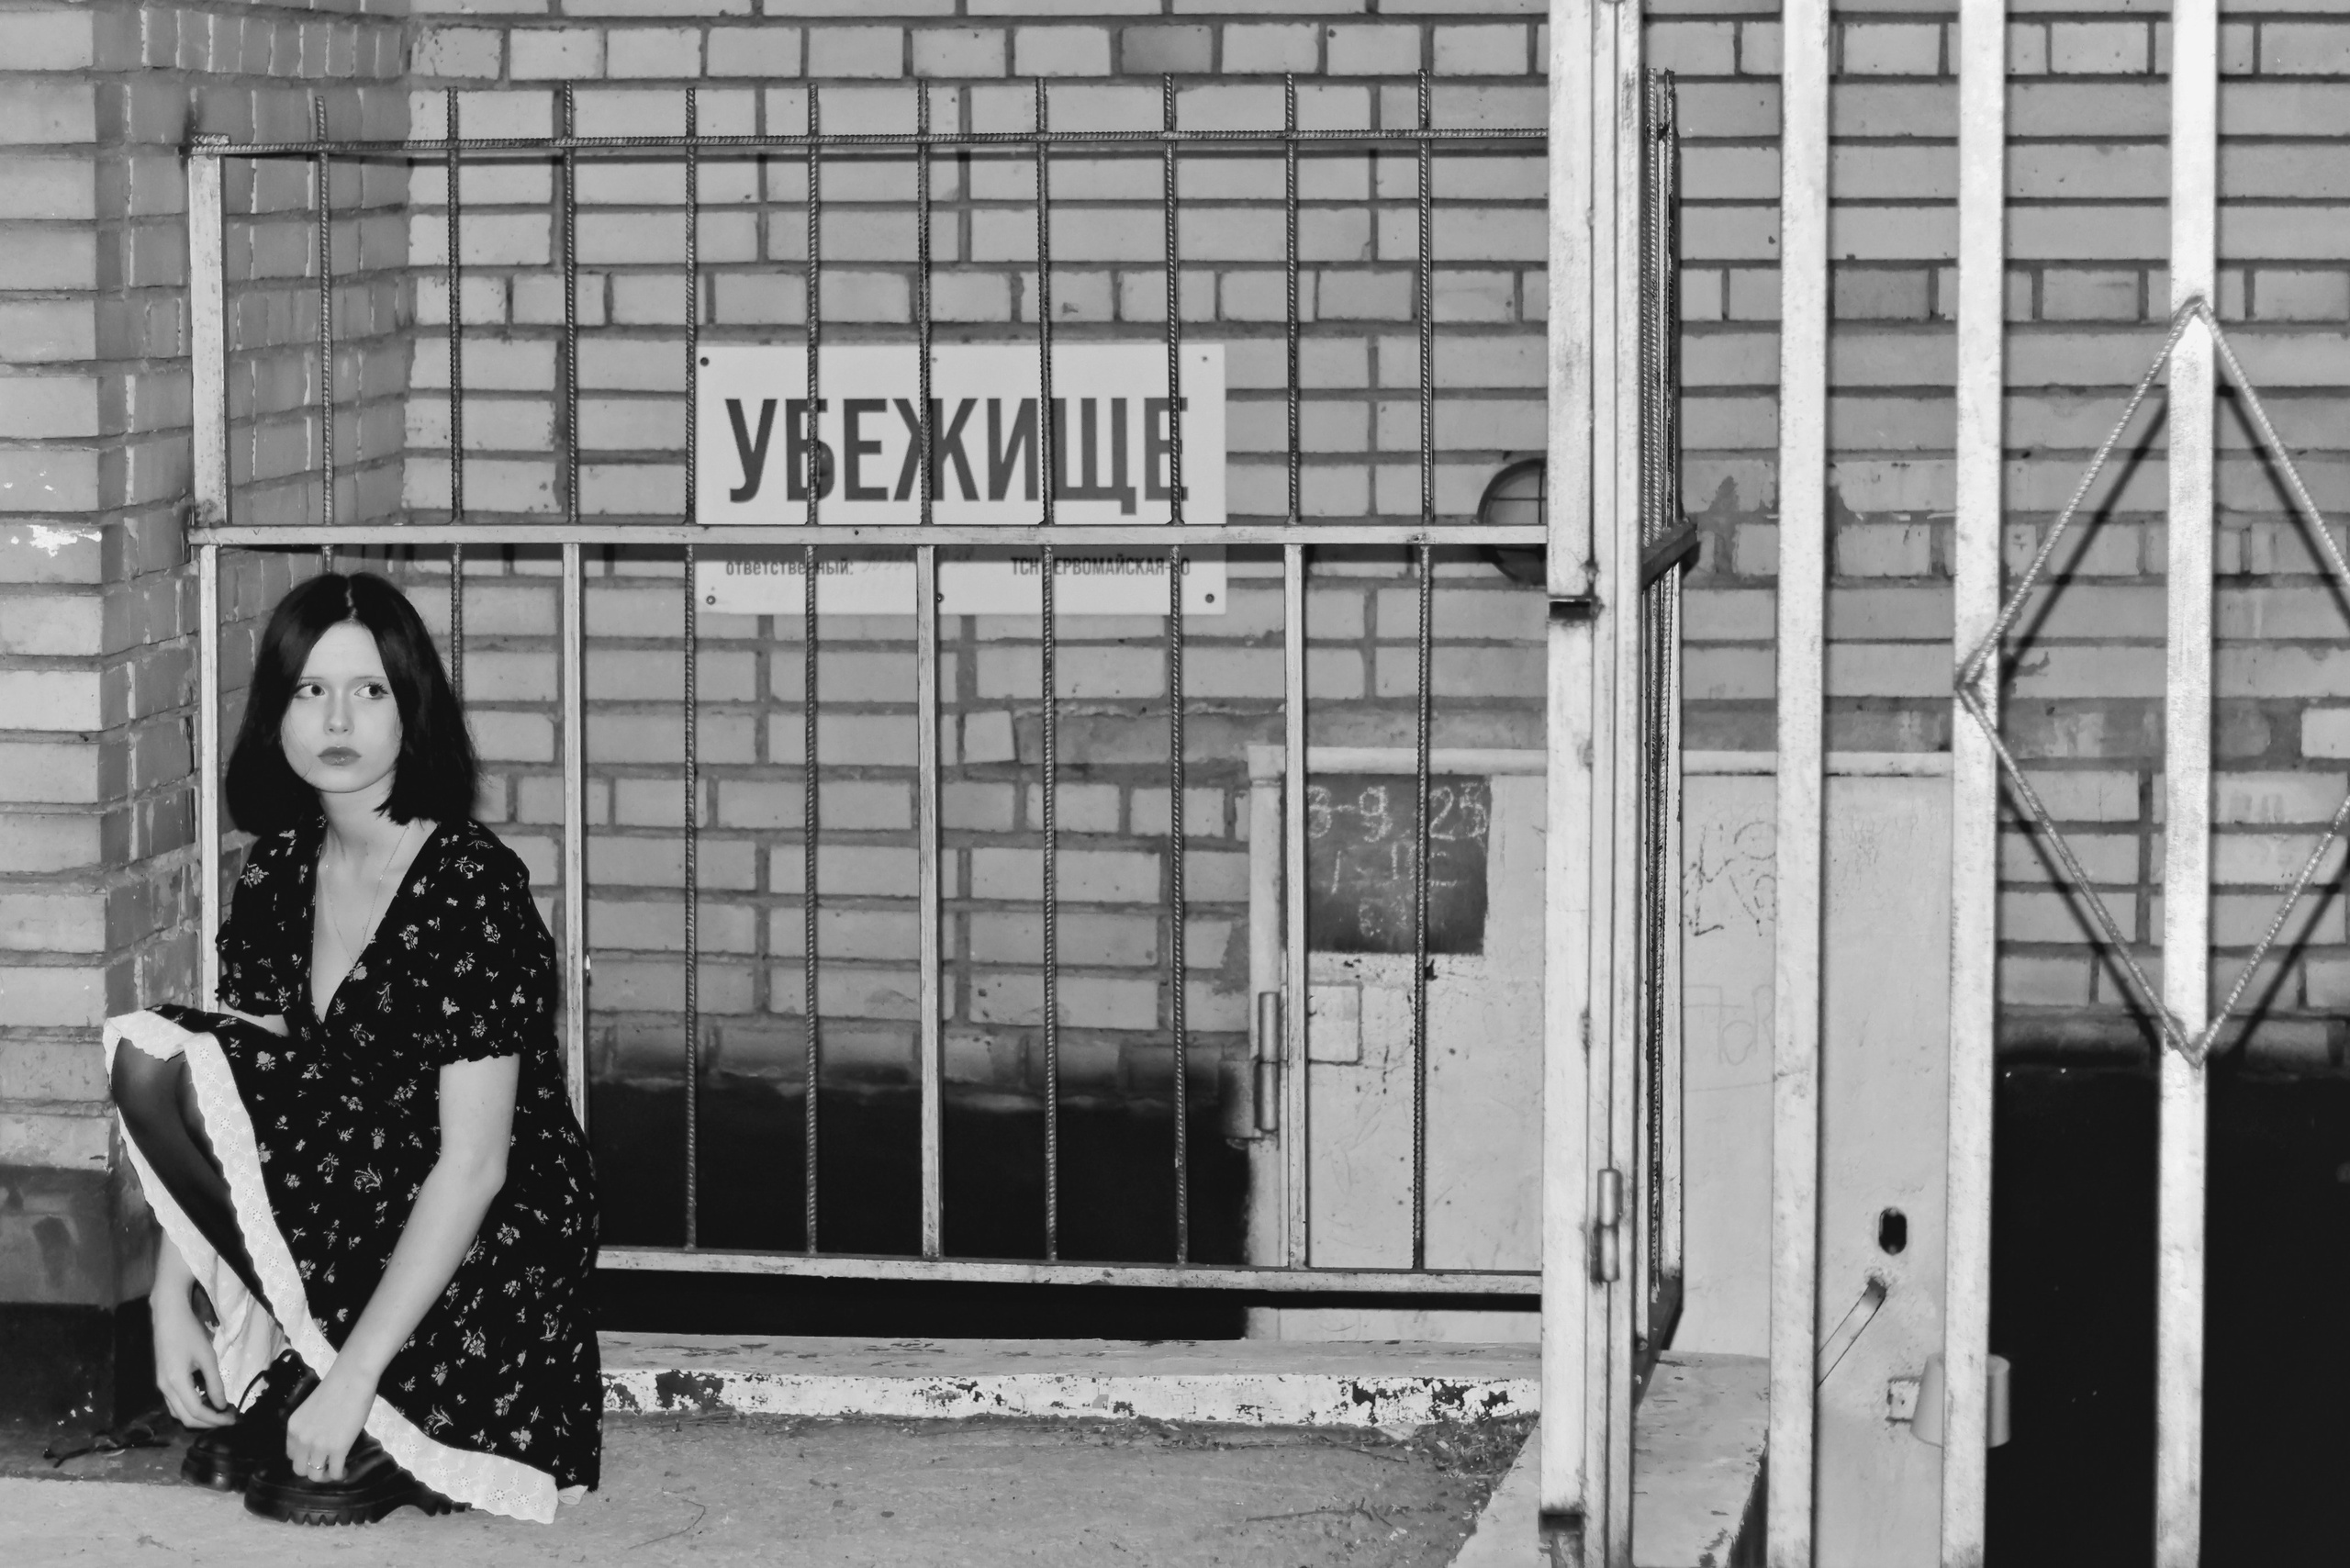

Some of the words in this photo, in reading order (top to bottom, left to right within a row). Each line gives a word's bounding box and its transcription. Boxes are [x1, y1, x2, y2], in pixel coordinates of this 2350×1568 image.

[725, 398, 1189, 515] УБЕЖИЩЕ
[725, 556, 854, 576] ответственый:
[1010, 555, 1040, 576] ТСН
